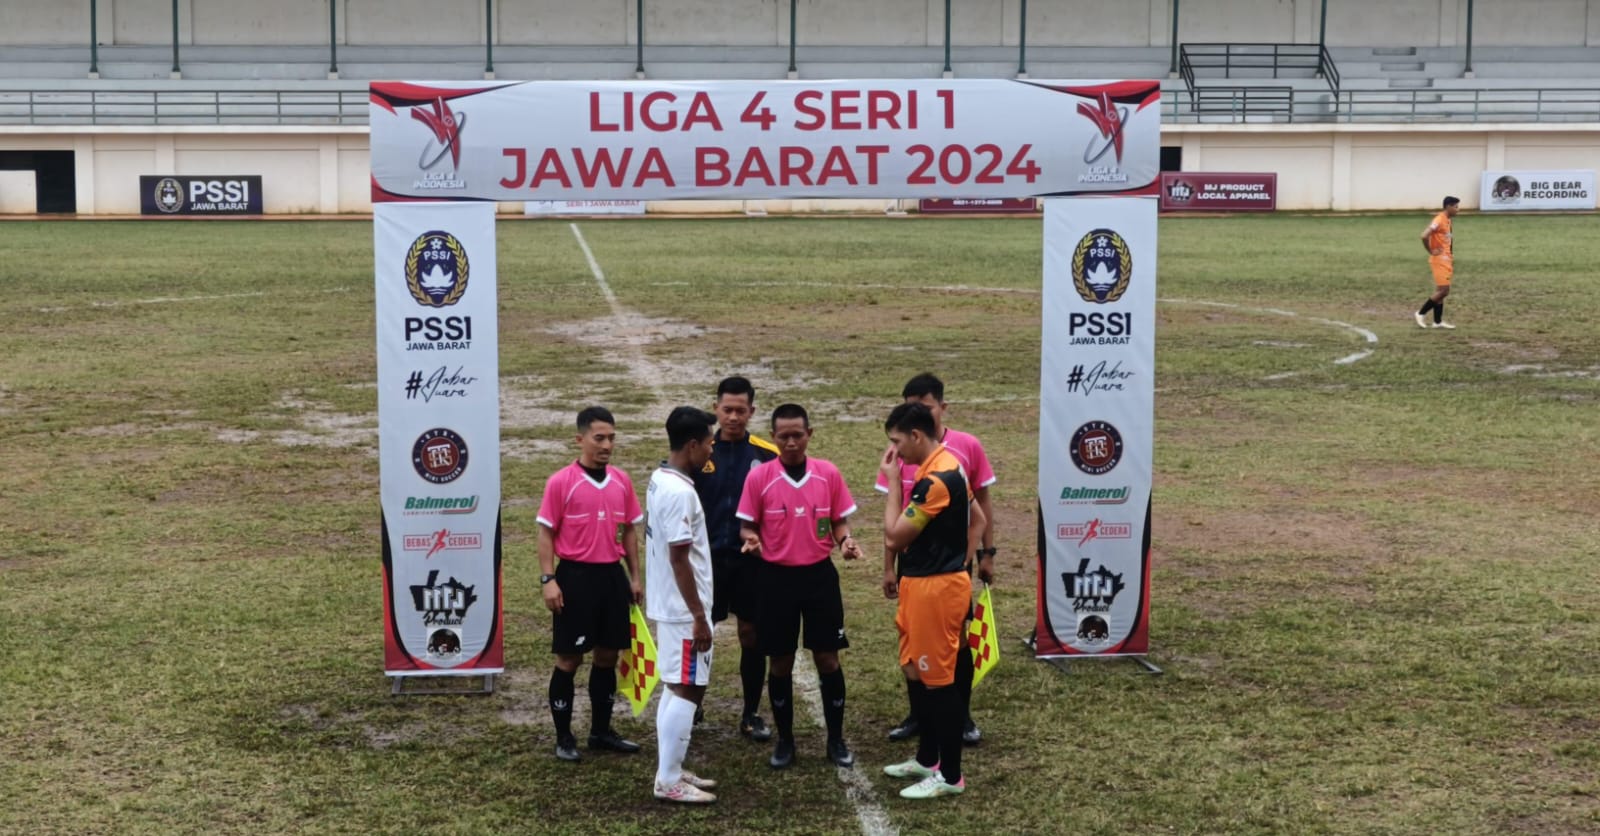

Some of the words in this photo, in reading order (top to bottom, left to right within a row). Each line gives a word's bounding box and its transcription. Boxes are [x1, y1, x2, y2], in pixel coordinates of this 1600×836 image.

[589, 91, 723, 132] LIGA
[739, 91, 776, 132] 4
[794, 89, 917, 131] SERI
[937, 90, 955, 130] 1
[499, 147, 676, 189] JAWA
[695, 144, 890, 188] BARAT
[905, 143, 1041, 186] 2024
[1088, 167, 1108, 175] LIGA
[1109, 167, 1117, 175] 4
[423, 172, 446, 181] LIGA
[1077, 174, 1127, 183] INDONESIA
[413, 180, 465, 189] INDONESIA
[1530, 181, 1549, 190] BIG
[1553, 181, 1582, 190] BEAR
[189, 180, 249, 203] PSSI
[1523, 190, 1588, 199] RECORDING
[191, 203, 216, 211] JAWA
[218, 202, 248, 211] BARAT
[423, 250, 451, 261] PSSI
[1090, 248, 1116, 258] PSSI
[405, 316, 472, 342] PSSI
[1069, 312, 1131, 336] PSSI
[406, 342, 436, 351] JAWA
[437, 341, 471, 351] BARAT
[1069, 337, 1096, 346] JAWA
[1098, 336, 1130, 345] BARAT
[1060, 486, 1127, 500] Balmerol
[404, 495, 476, 509] Balmerol
[1060, 525, 1084, 537] BEBAS
[1100, 525, 1128, 537] CEDERA
[406, 536, 431, 549] BEBAS
[448, 535, 480, 547] CEDERA
[1072, 597, 1110, 613] Product
[422, 610, 463, 628] Product
[917, 654, 929, 672] 6
